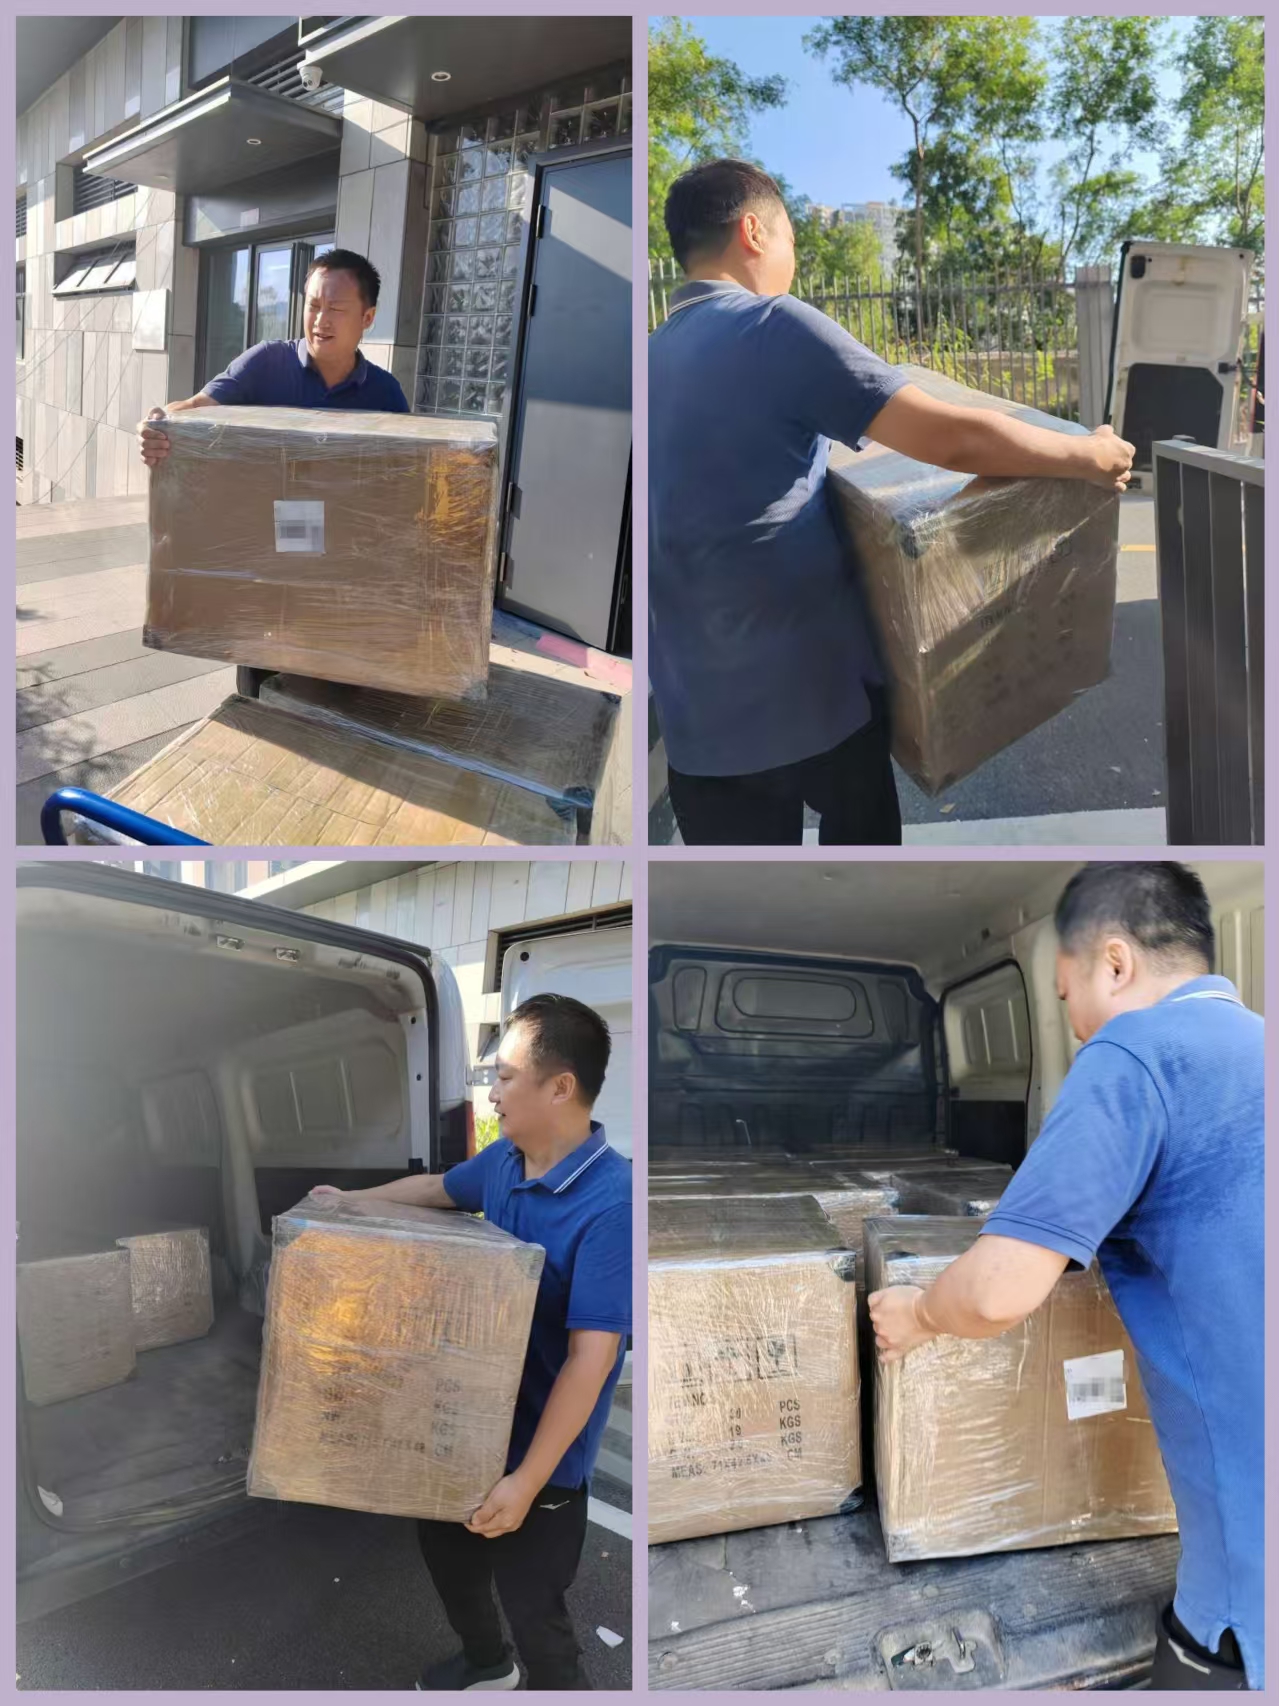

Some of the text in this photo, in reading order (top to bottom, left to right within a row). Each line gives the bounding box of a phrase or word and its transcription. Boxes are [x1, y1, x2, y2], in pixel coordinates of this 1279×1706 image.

[779, 1399, 801, 1413] PCS
[729, 1415, 801, 1437] 19 KGS
[780, 1431, 802, 1447] KGS
